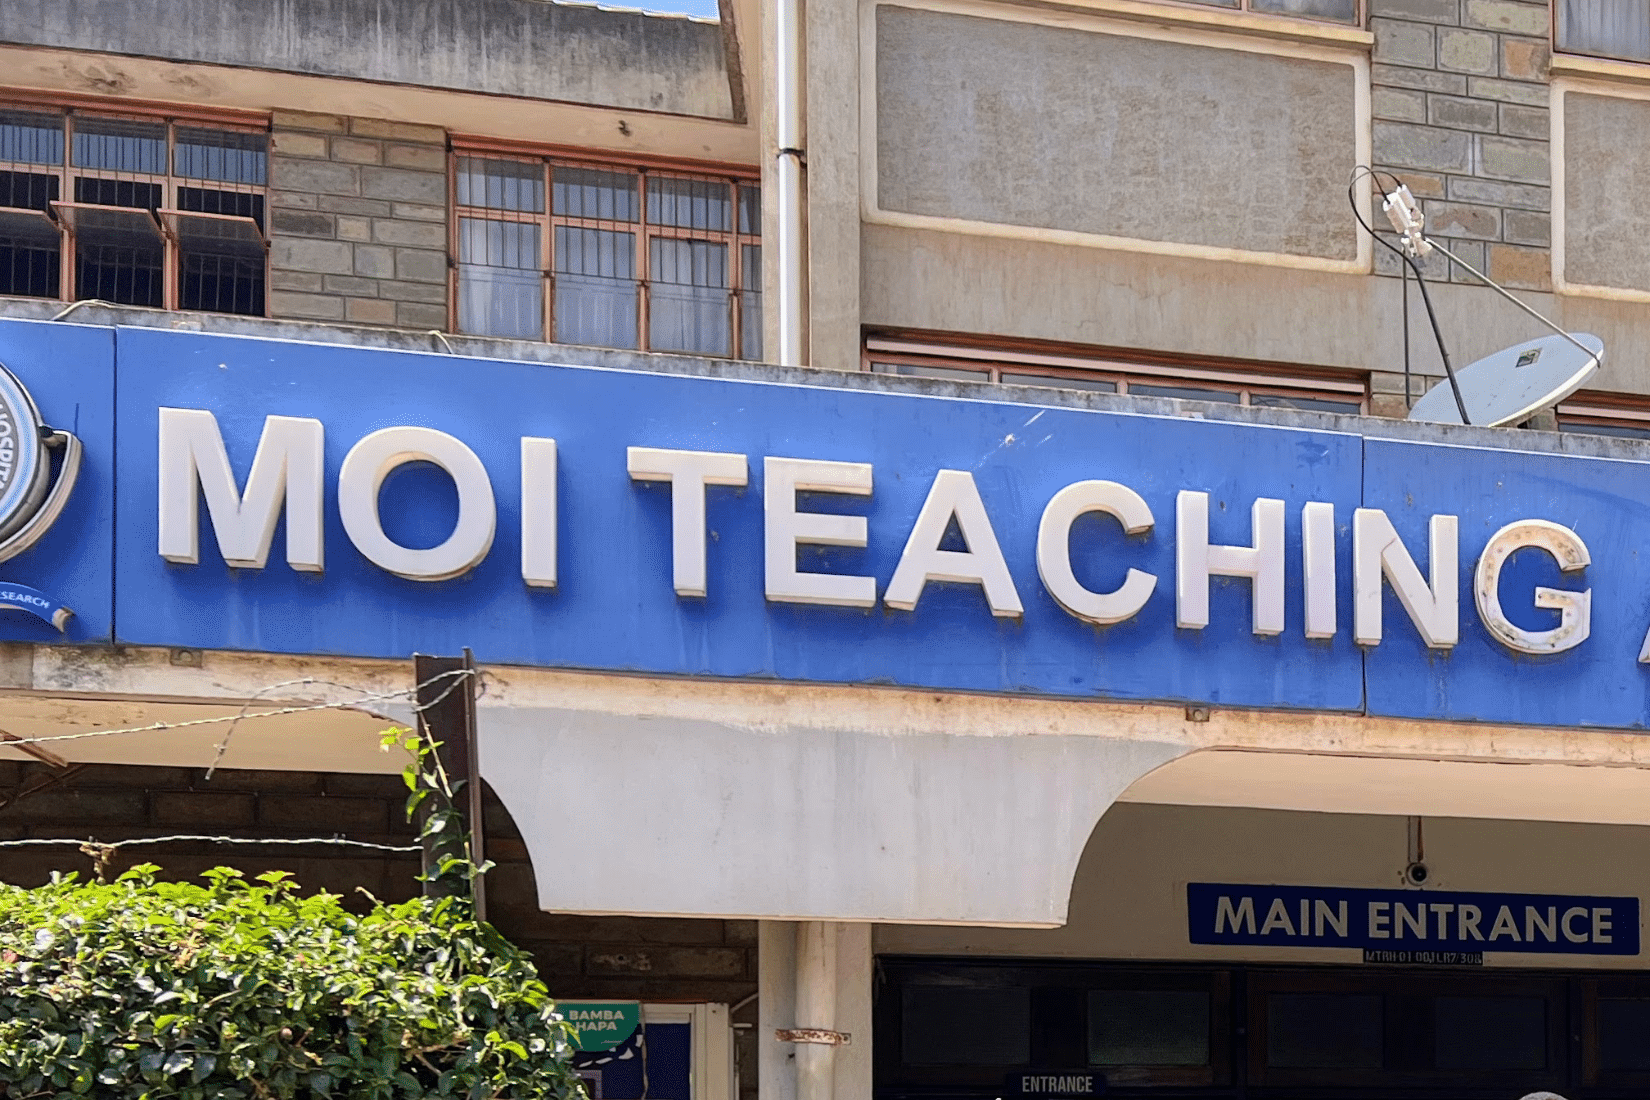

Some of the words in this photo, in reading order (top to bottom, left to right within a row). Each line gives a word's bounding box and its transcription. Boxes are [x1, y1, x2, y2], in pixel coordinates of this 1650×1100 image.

[158, 406, 558, 588] MOI
[627, 446, 1592, 655] TEACHING
[0, 591, 50, 609] SEARCH
[1214, 896, 1348, 938] MAIN
[1368, 902, 1613, 944] ENTRANCE
[569, 1010, 625, 1021] BAMBA
[575, 1021, 617, 1031] HAPA
[1022, 1076, 1093, 1093] ENTRANCE
